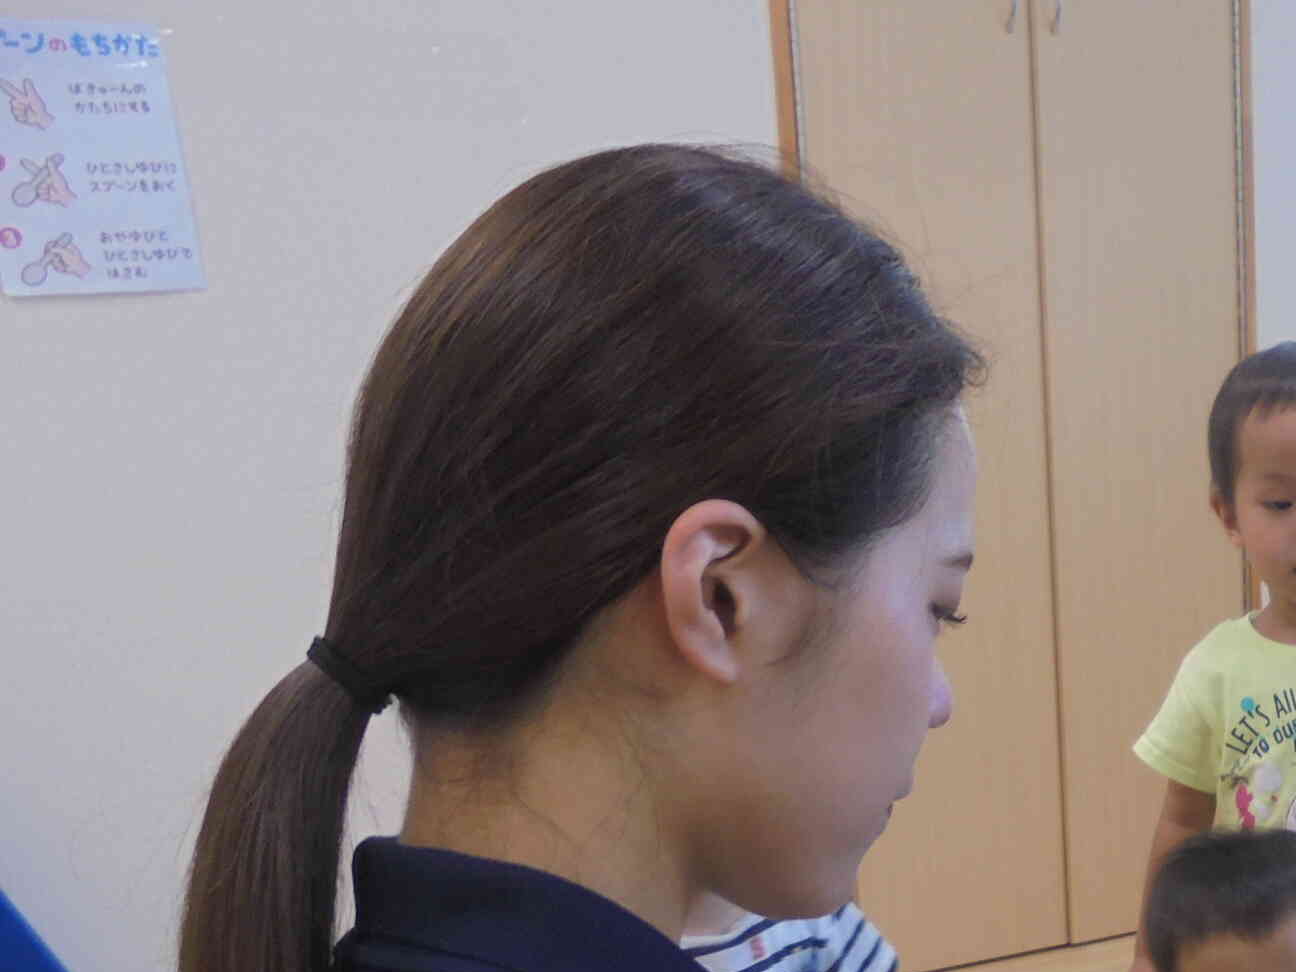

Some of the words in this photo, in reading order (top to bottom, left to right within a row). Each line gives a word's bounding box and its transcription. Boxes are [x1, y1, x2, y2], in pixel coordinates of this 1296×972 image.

[0, 28, 159, 57] ーンのもちかた
[1225, 703, 1271, 755] LET'S
[1252, 740, 1270, 759] TO
